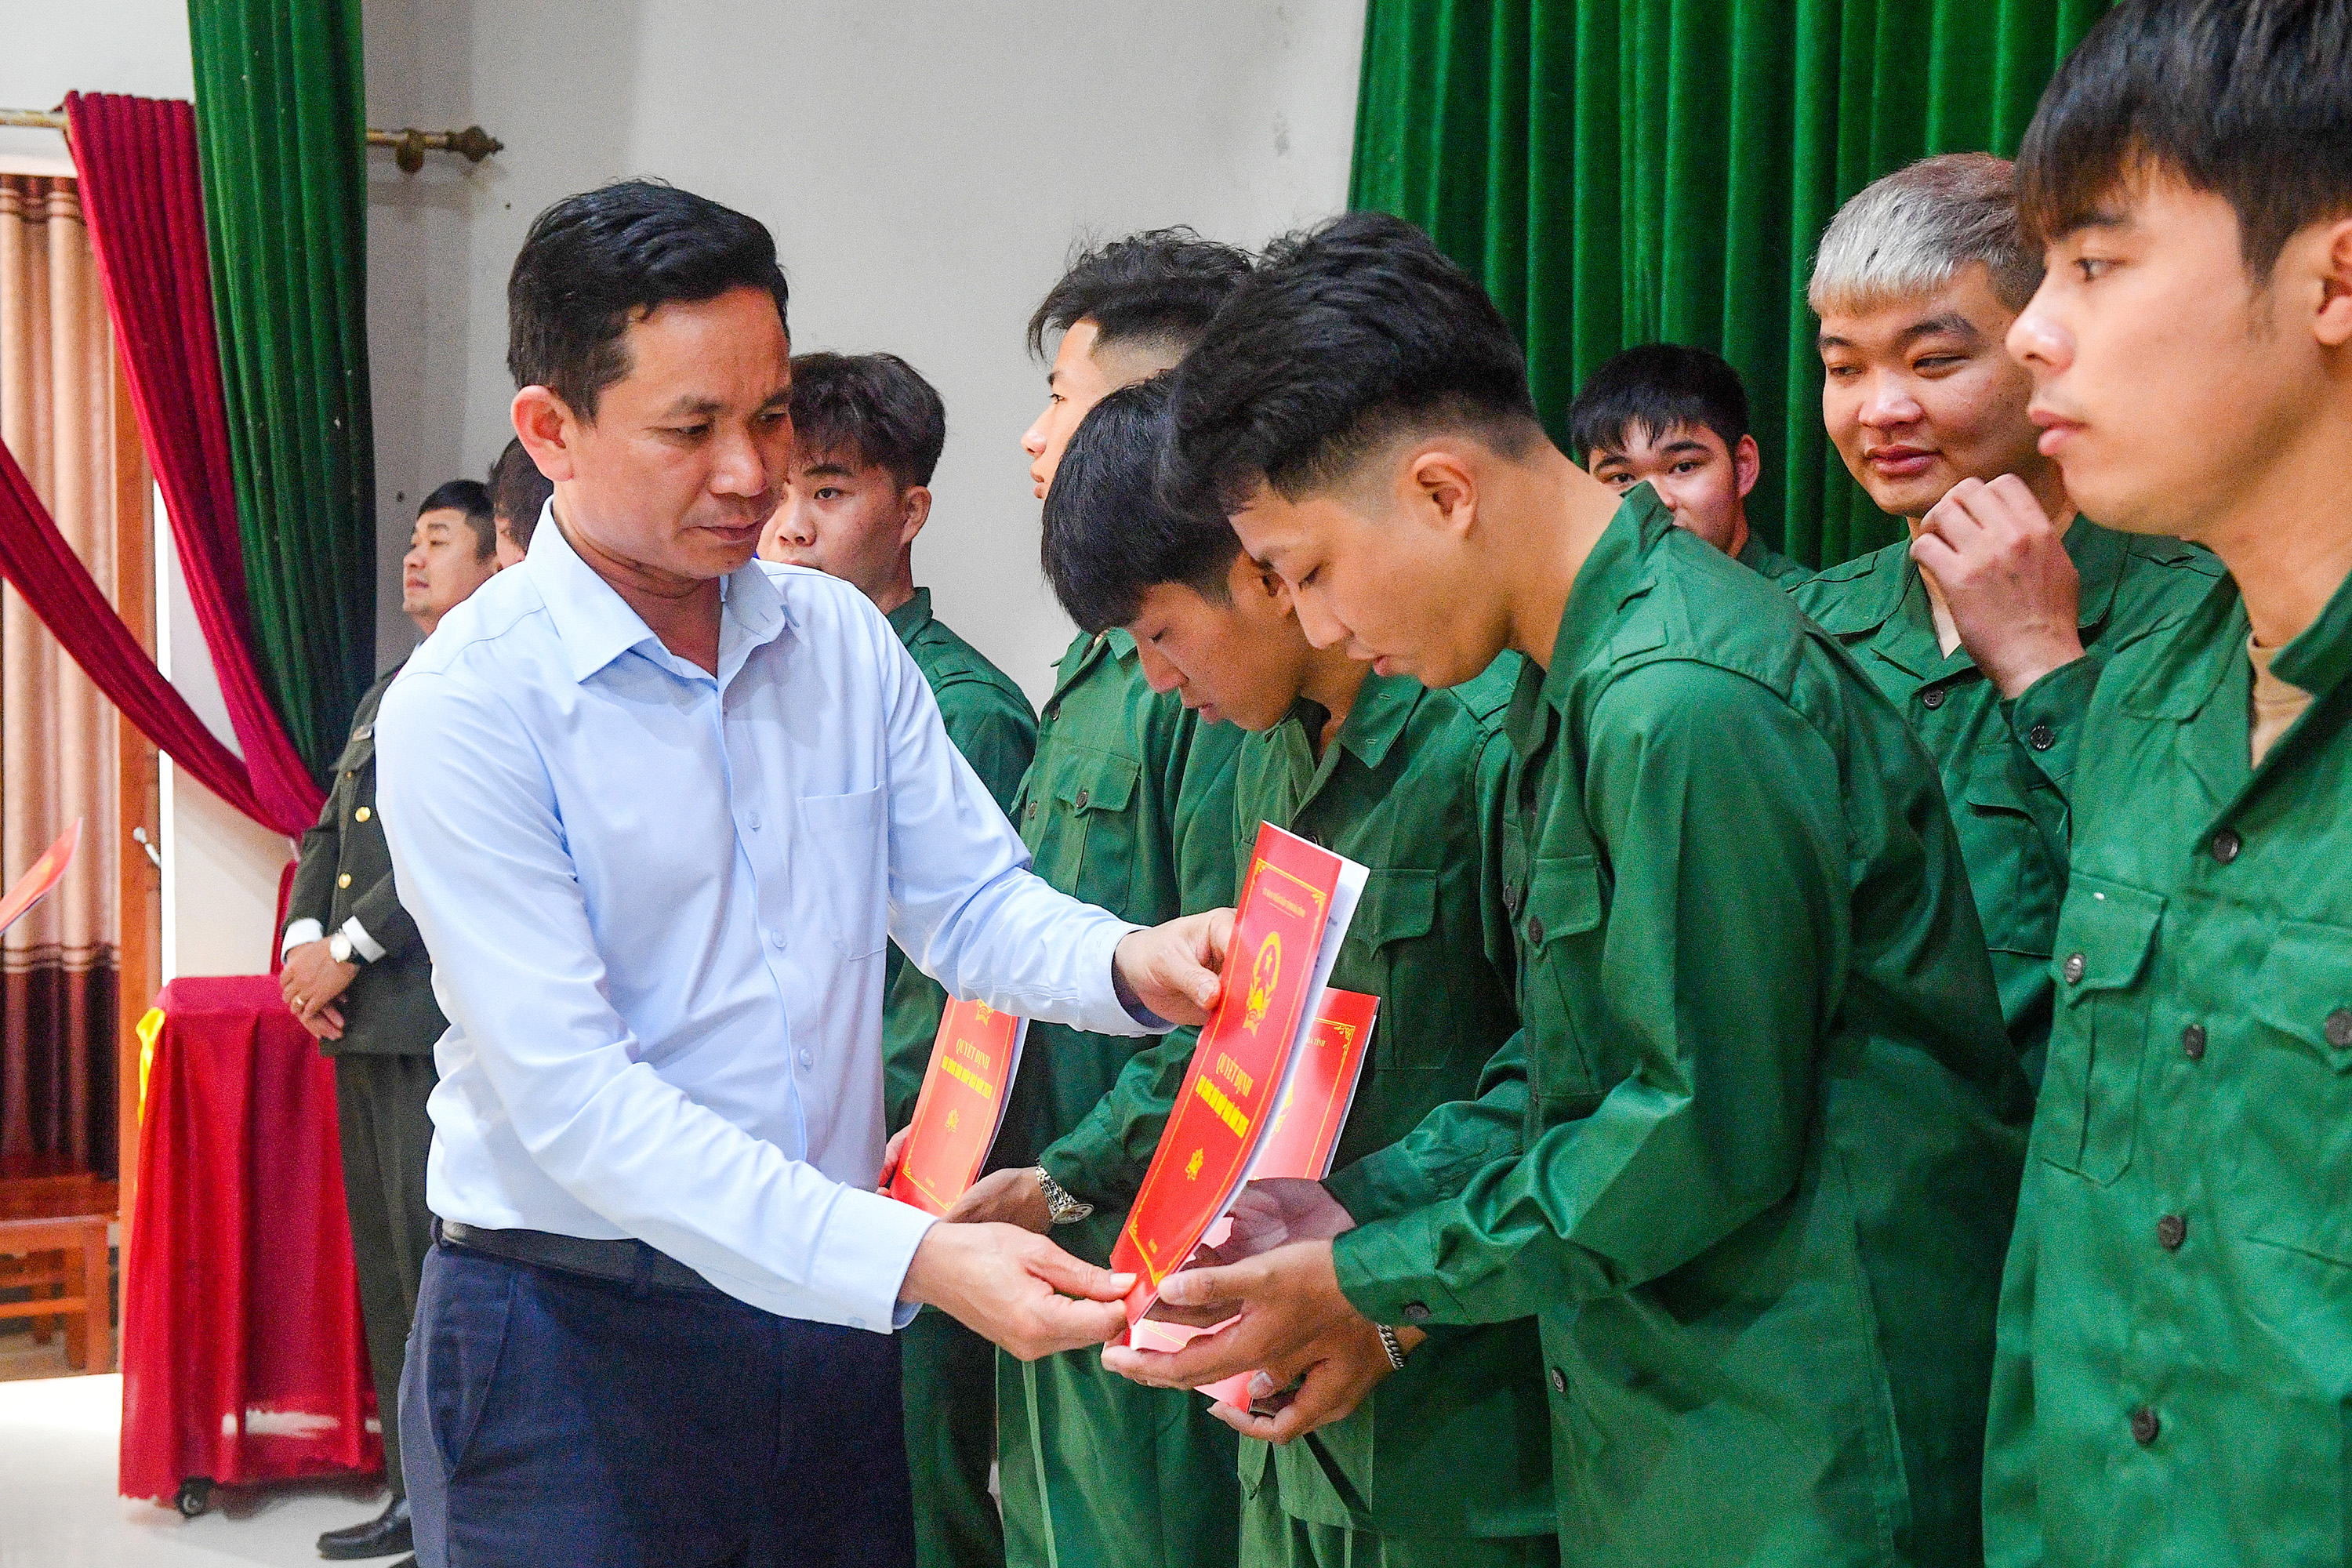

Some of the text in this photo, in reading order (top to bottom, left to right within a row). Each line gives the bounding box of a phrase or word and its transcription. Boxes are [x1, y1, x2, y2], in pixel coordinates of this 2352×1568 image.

[956, 1037, 990, 1070] QUYẾT ĐỊNH
[1215, 1052, 1239, 1083] QUYẾT
